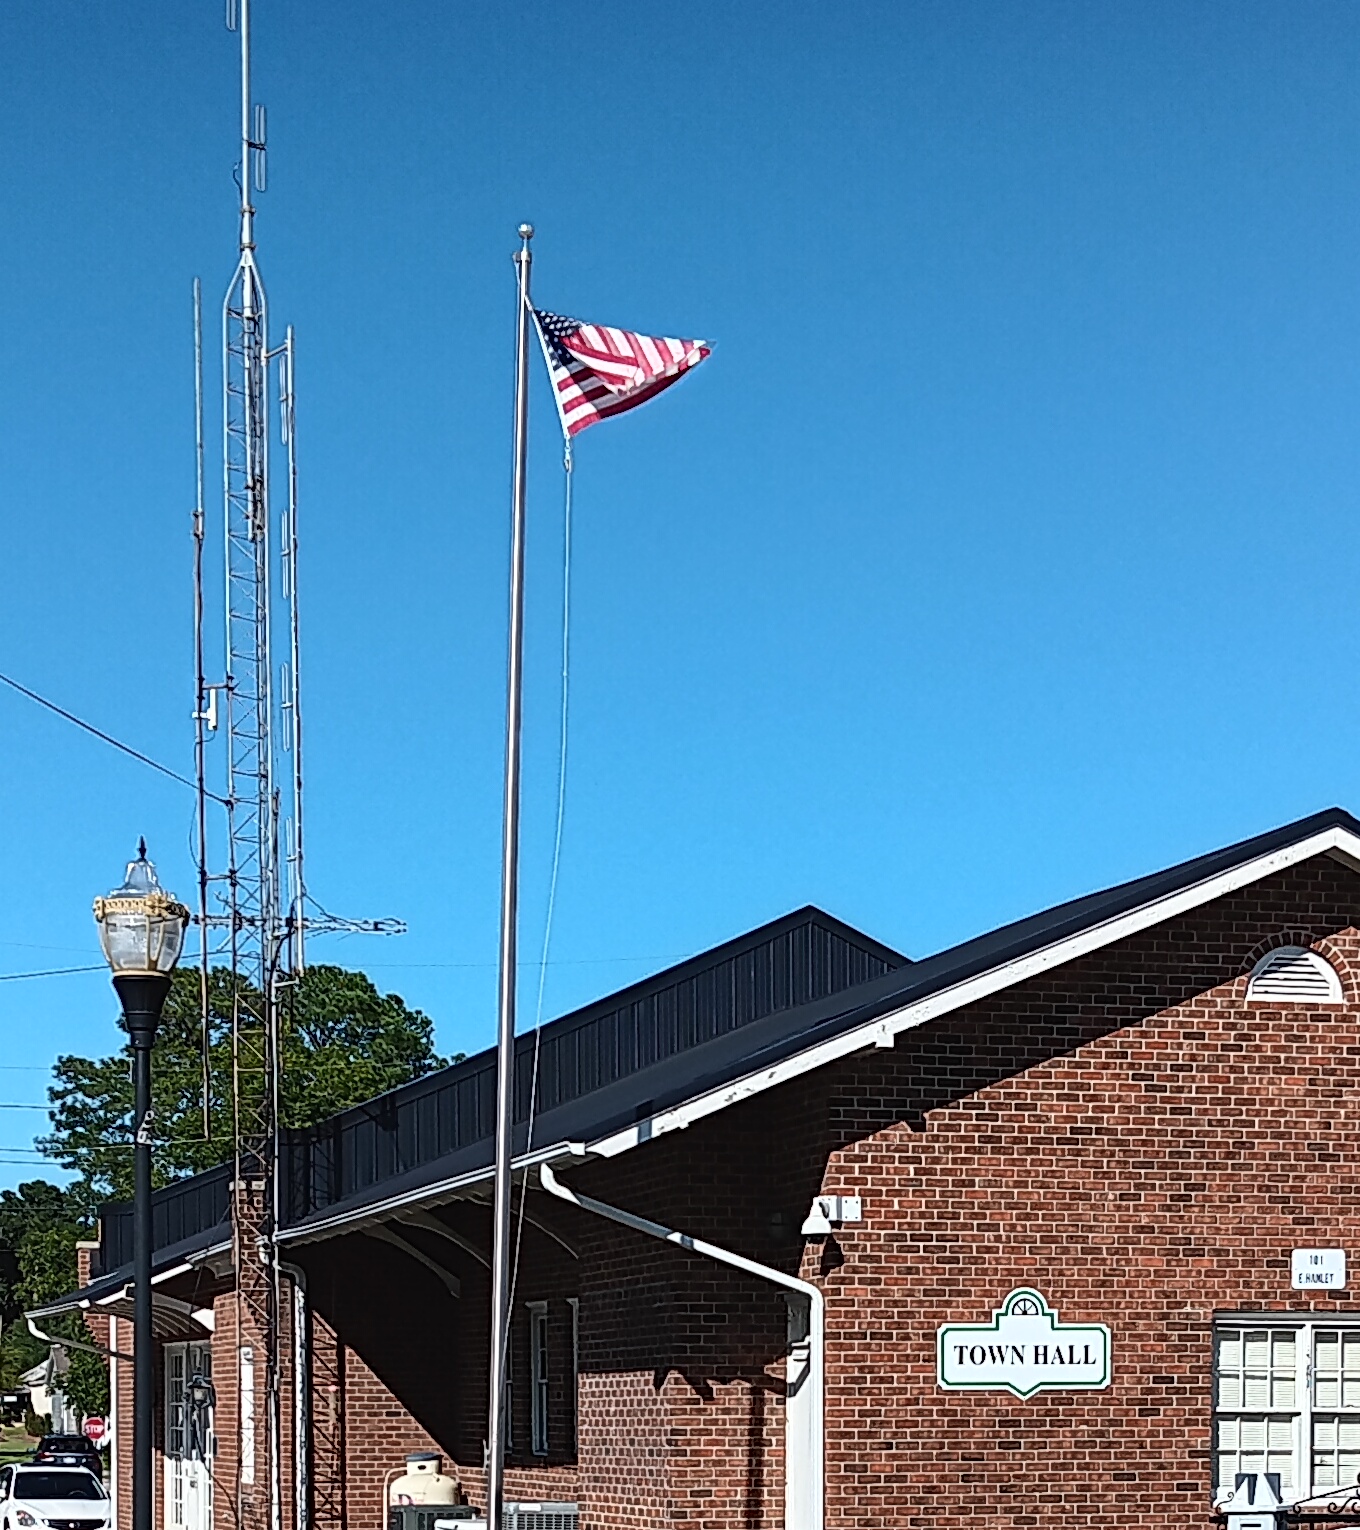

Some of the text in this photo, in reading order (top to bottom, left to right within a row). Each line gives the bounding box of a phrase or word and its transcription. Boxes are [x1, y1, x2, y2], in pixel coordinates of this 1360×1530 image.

[1309, 1254, 1323, 1265] 101
[953, 1344, 1097, 1366] TOWN HALL
